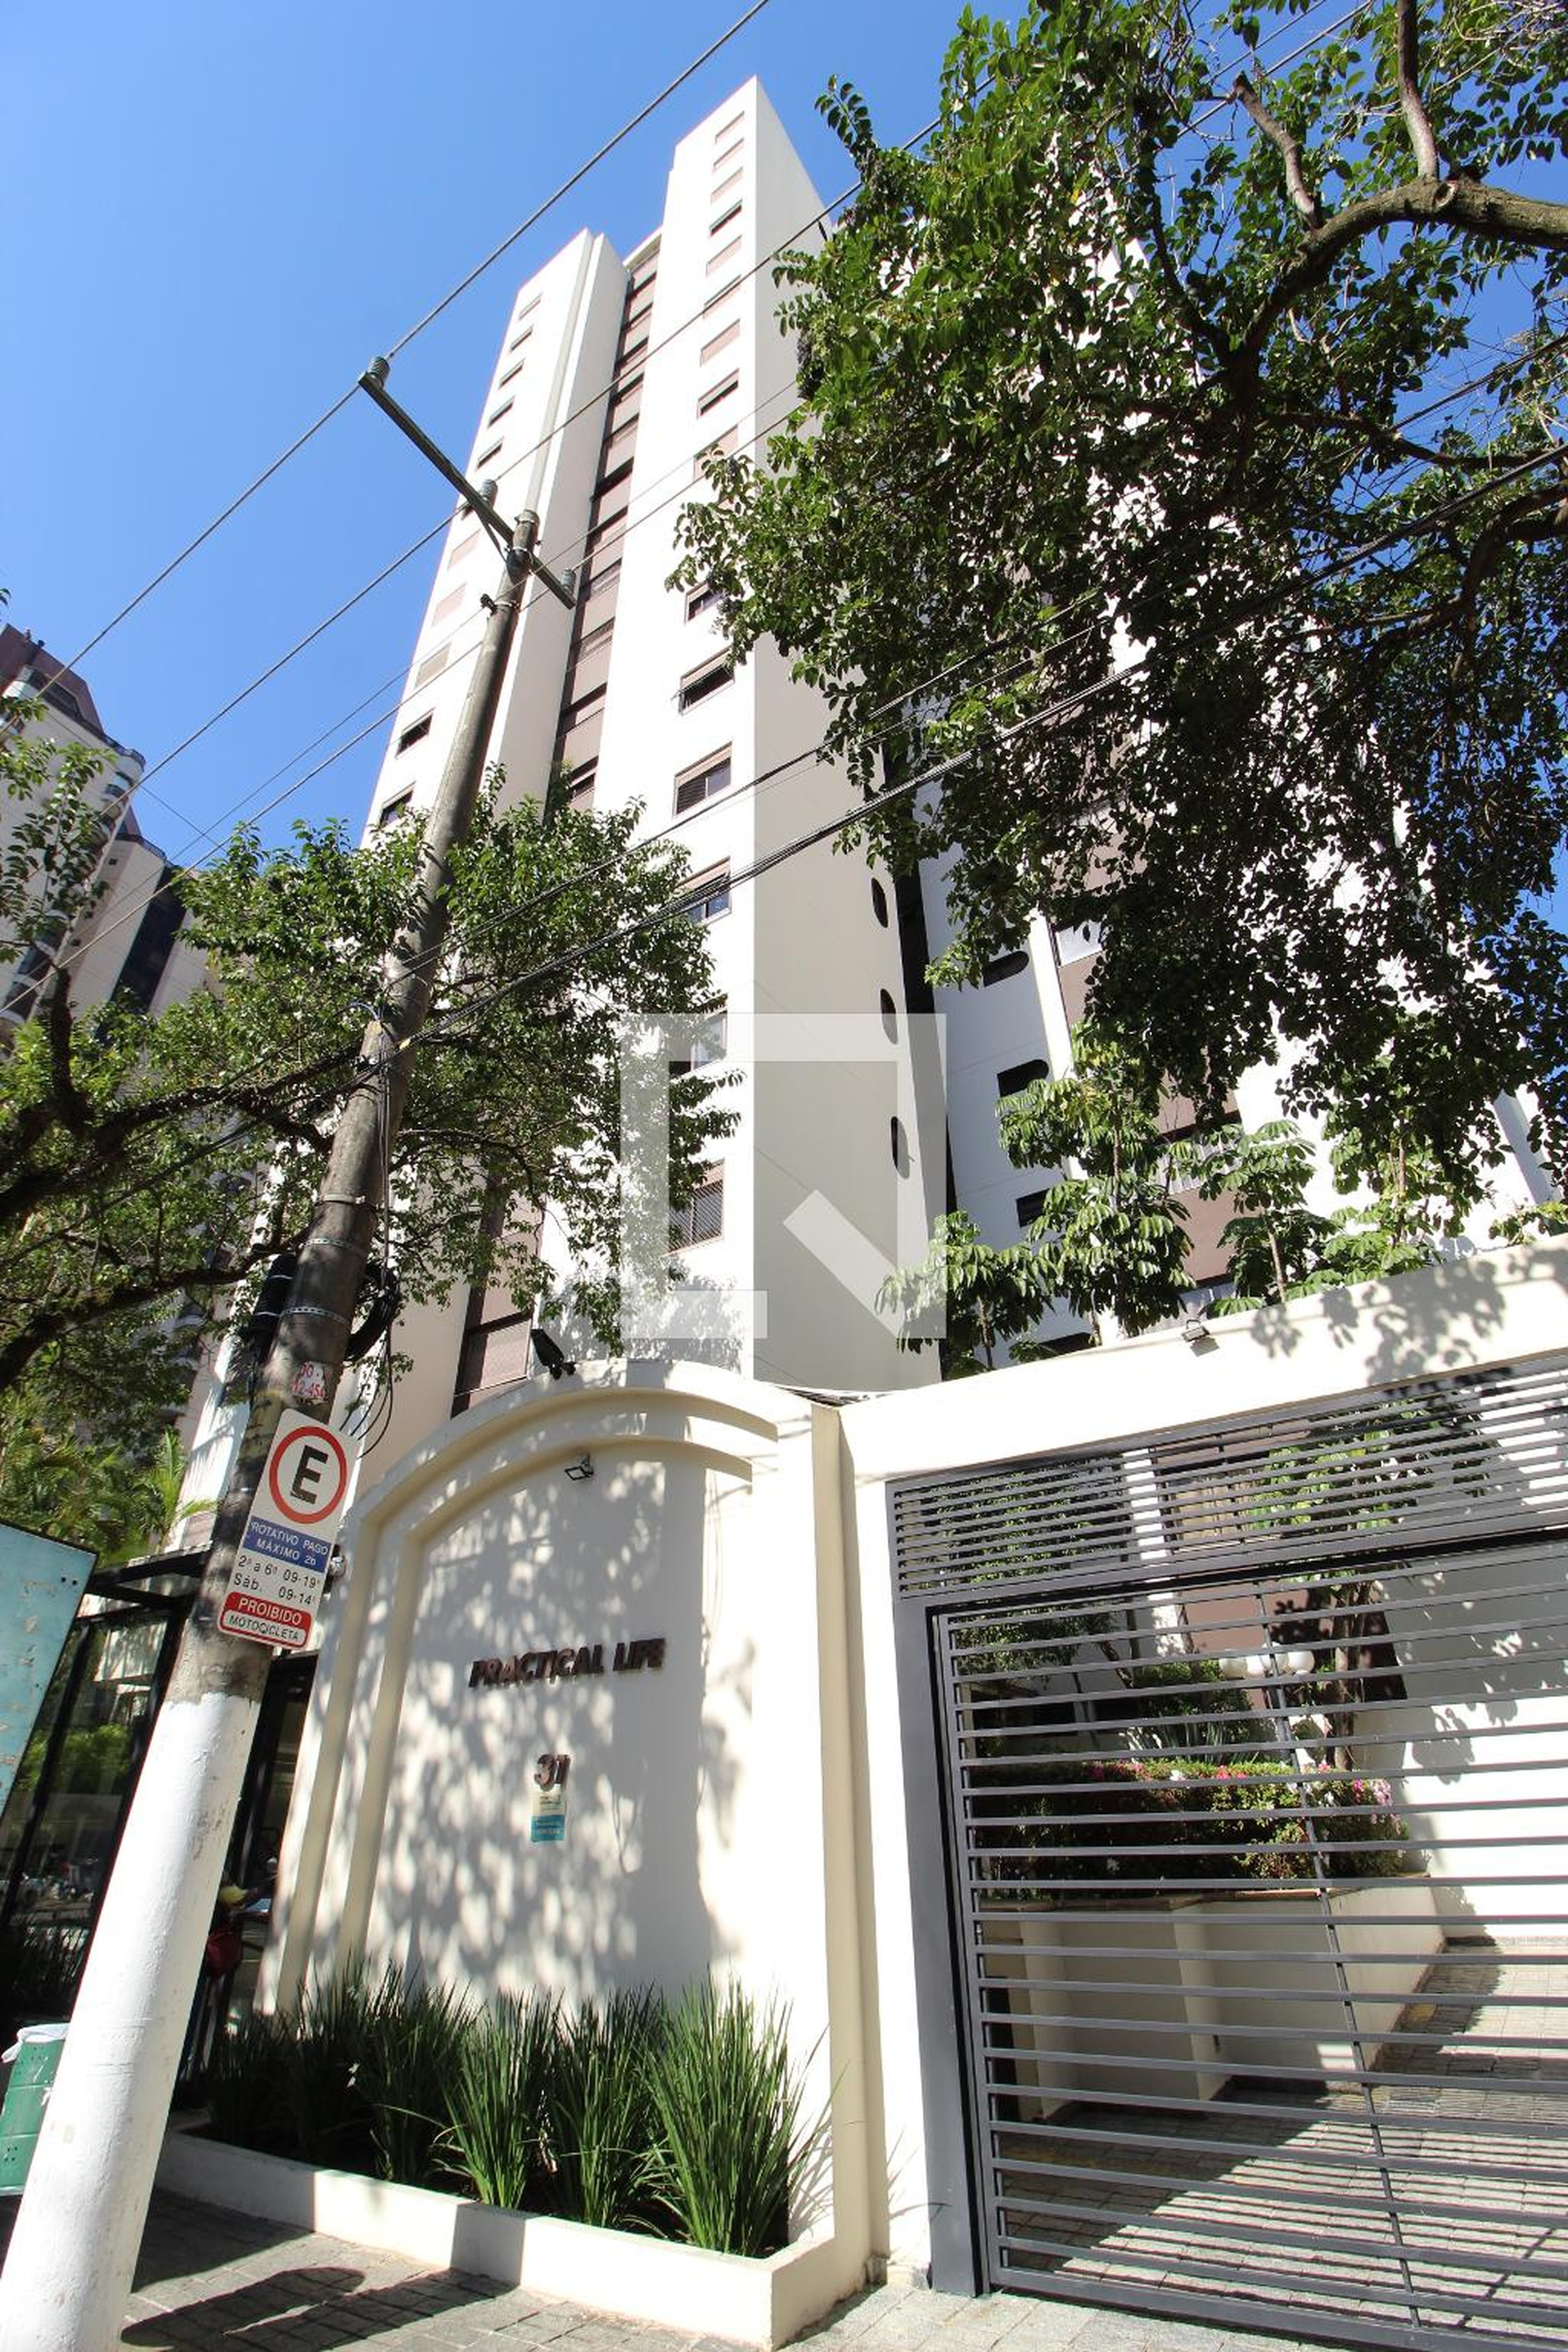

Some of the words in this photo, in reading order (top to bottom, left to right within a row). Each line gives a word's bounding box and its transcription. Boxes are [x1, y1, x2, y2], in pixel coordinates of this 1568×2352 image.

[290, 1445, 328, 1504] E
[251, 1521, 299, 1546] ROTATIVO
[303, 1540, 328, 1555] PAGO
[256, 1538, 300, 1560] MÁXIMO
[254, 1563, 261, 1571] a
[238, 1597, 302, 1626] PROIBIDO
[229, 1615, 298, 1640] MOTOCICLETA
[468, 1644, 604, 1688] PRACTICAL
[612, 1638, 666, 1671] LIFE
[534, 1755, 571, 1792] 31
